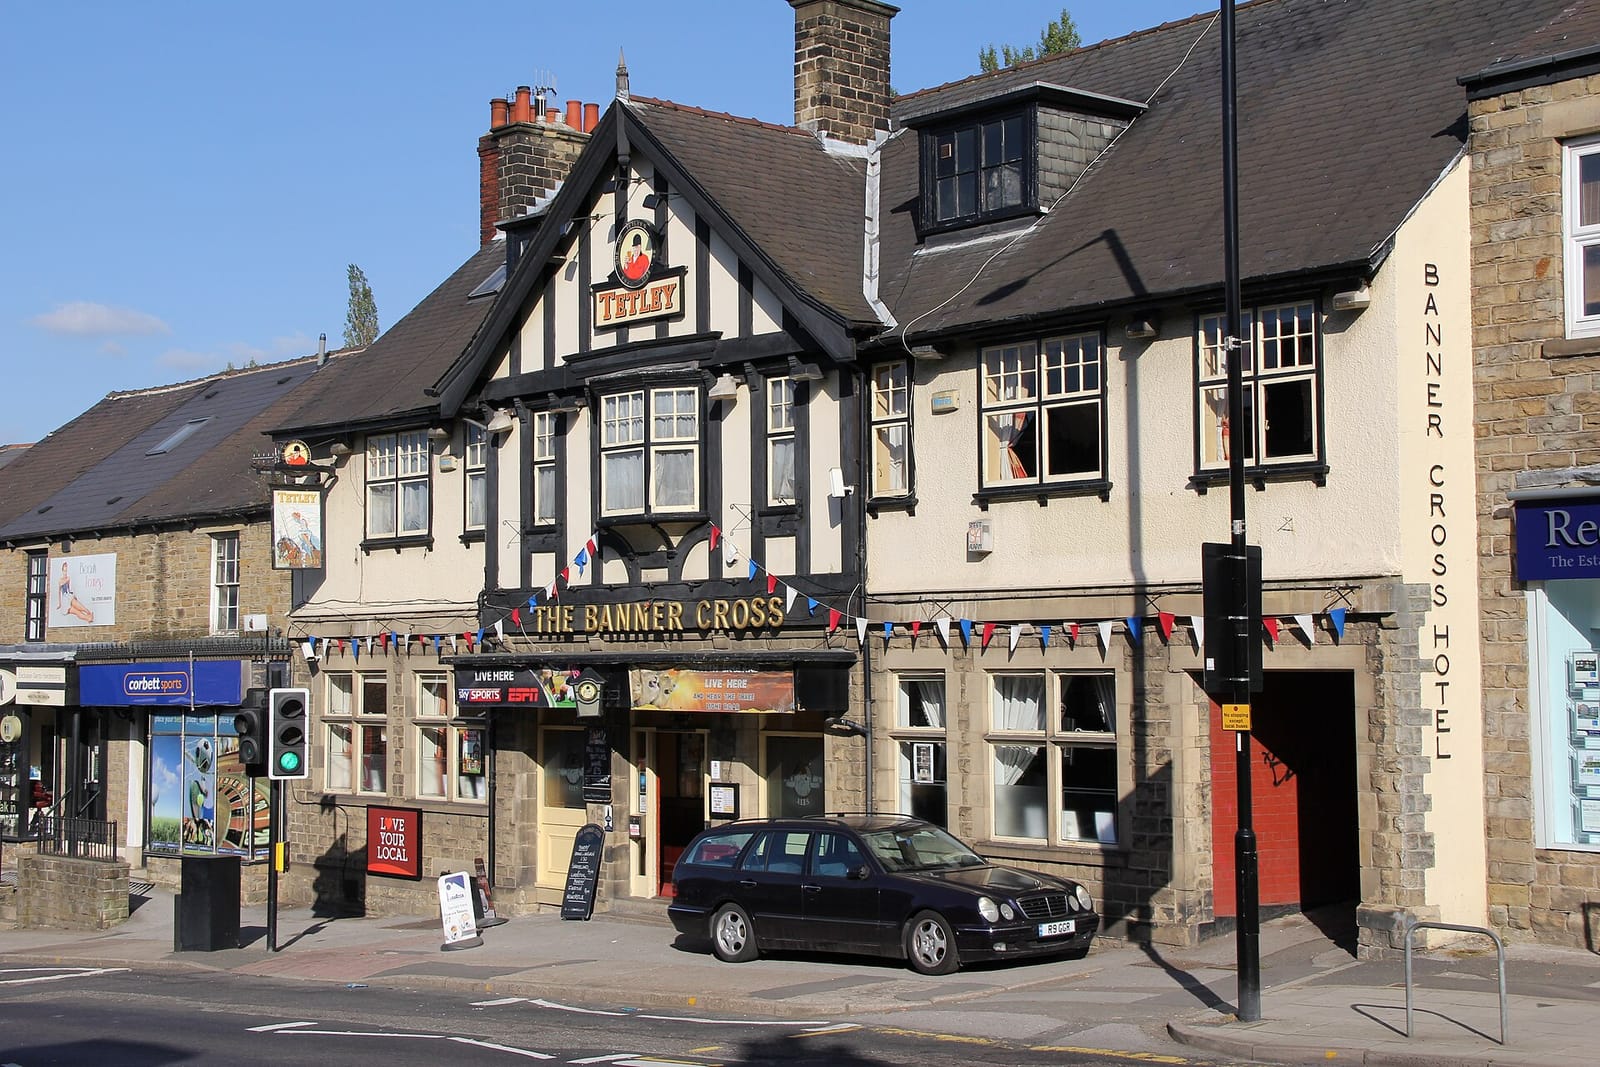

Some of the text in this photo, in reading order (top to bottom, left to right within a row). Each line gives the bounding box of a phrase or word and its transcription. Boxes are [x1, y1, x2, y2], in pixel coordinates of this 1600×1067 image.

[599, 283, 676, 320] TETLEY
[277, 492, 317, 503] TETLEY
[1424, 263, 1451, 759] BANNER CROSS HOTEL
[1544, 510, 1600, 547] Re
[1548, 555, 1574, 568] The
[534, 596, 785, 634] THE BANNER CROSS
[474, 670, 515, 682] LIVE HERE
[128, 676, 182, 693] corbett sports
[704, 679, 748, 689] LIVE HERE
[458, 688, 500, 701] sky SPORTS
[507, 687, 539, 703] ESPN
[380, 832, 405, 847] YOUR
[377, 846, 408, 861] LOCAL
[1047, 923, 1057, 934] R9
